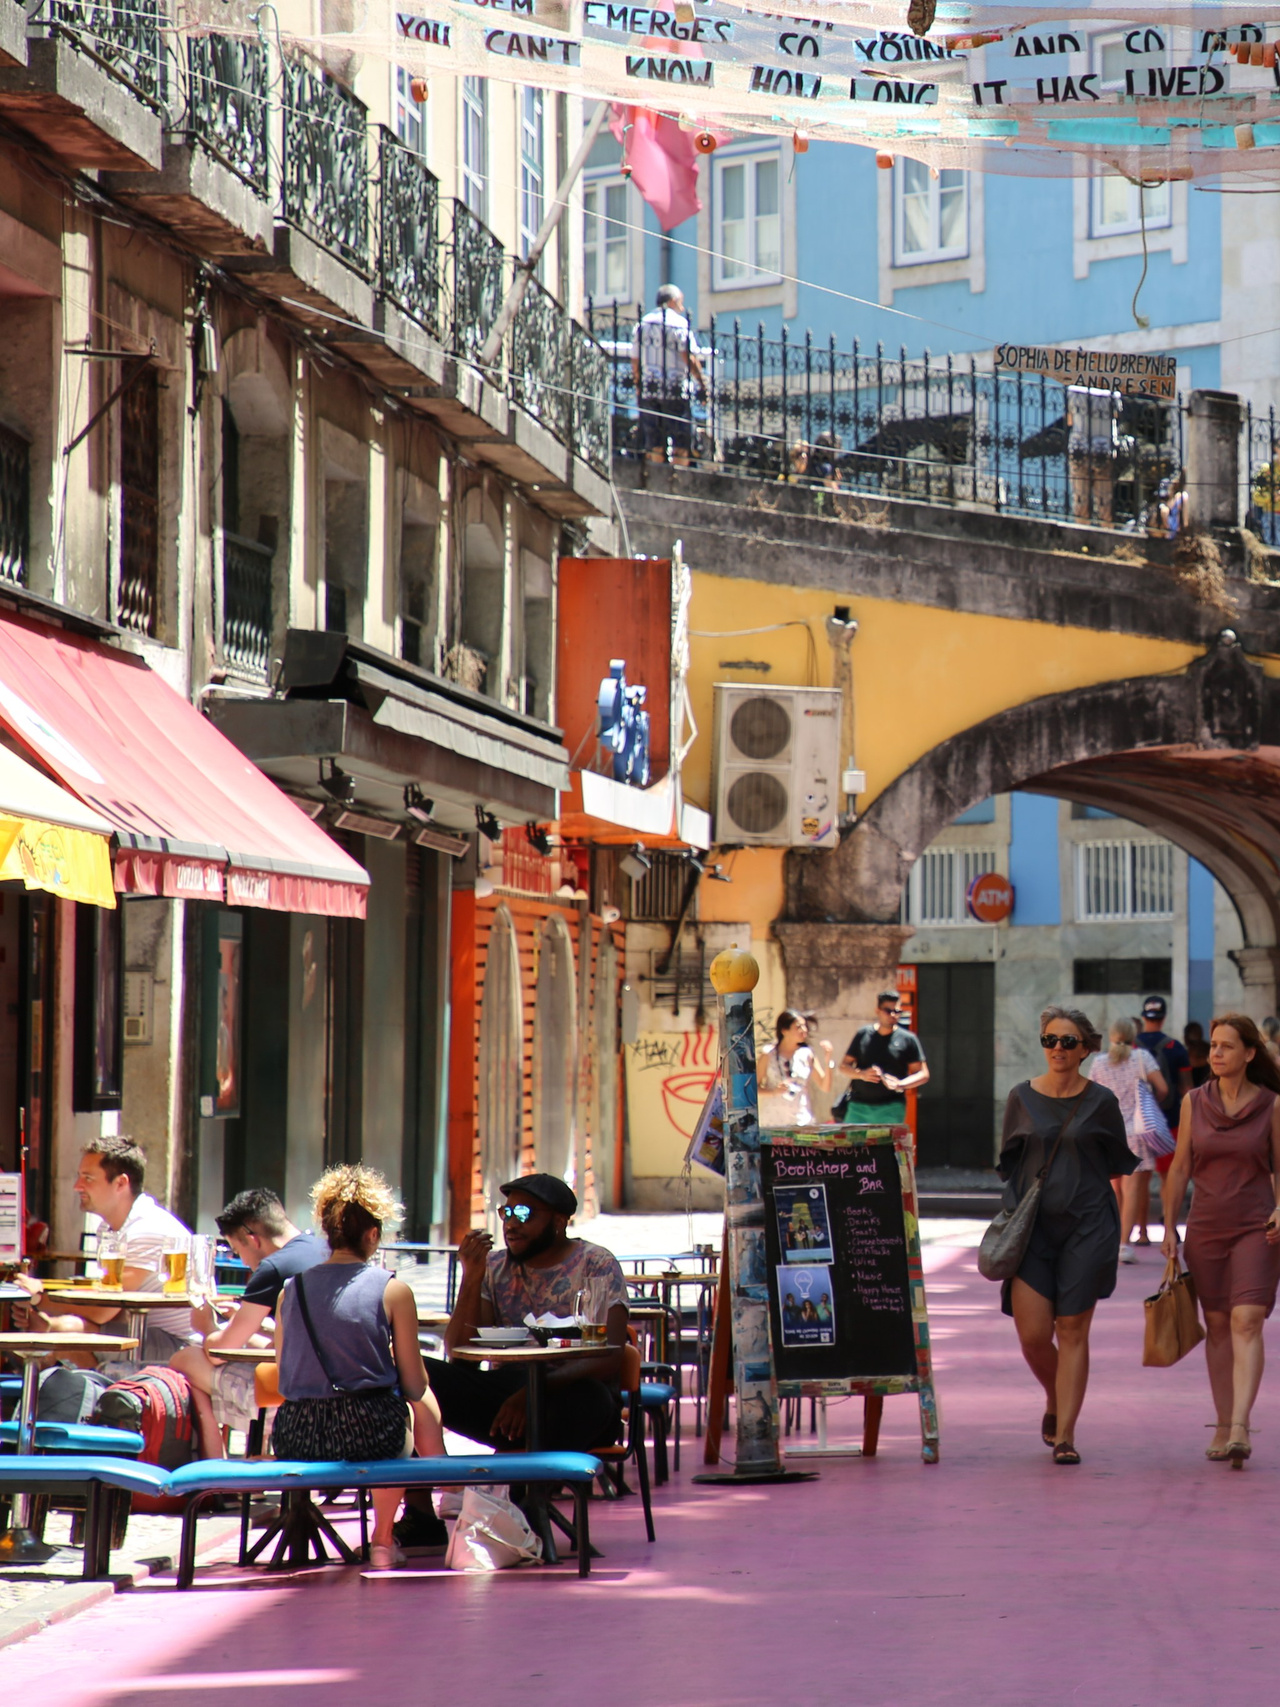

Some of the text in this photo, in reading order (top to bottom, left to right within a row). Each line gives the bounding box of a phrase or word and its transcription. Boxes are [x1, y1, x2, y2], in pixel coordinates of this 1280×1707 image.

[584, 2, 733, 44] EMERGES
[779, 32, 819, 58] SO
[1015, 33, 1081, 57] AND
[1125, 28, 1165, 54] SO
[397, 13, 451, 47] YOU
[485, 30, 579, 64] CAN'T
[625, 55, 713, 87] KNOW
[751, 65, 822, 98] HOW
[973, 80, 1008, 105] IT
[1037, 74, 1100, 104] HAS
[1125, 66, 1224, 96] LIVED
[994, 345, 1177, 377] SOPHIA DE MELLO BREYNER
[977, 890, 1010, 905] ATM
[896, 968, 916, 985] TM
[856, 1158, 877, 1174] and
[859, 1178, 884, 1194] BAR
